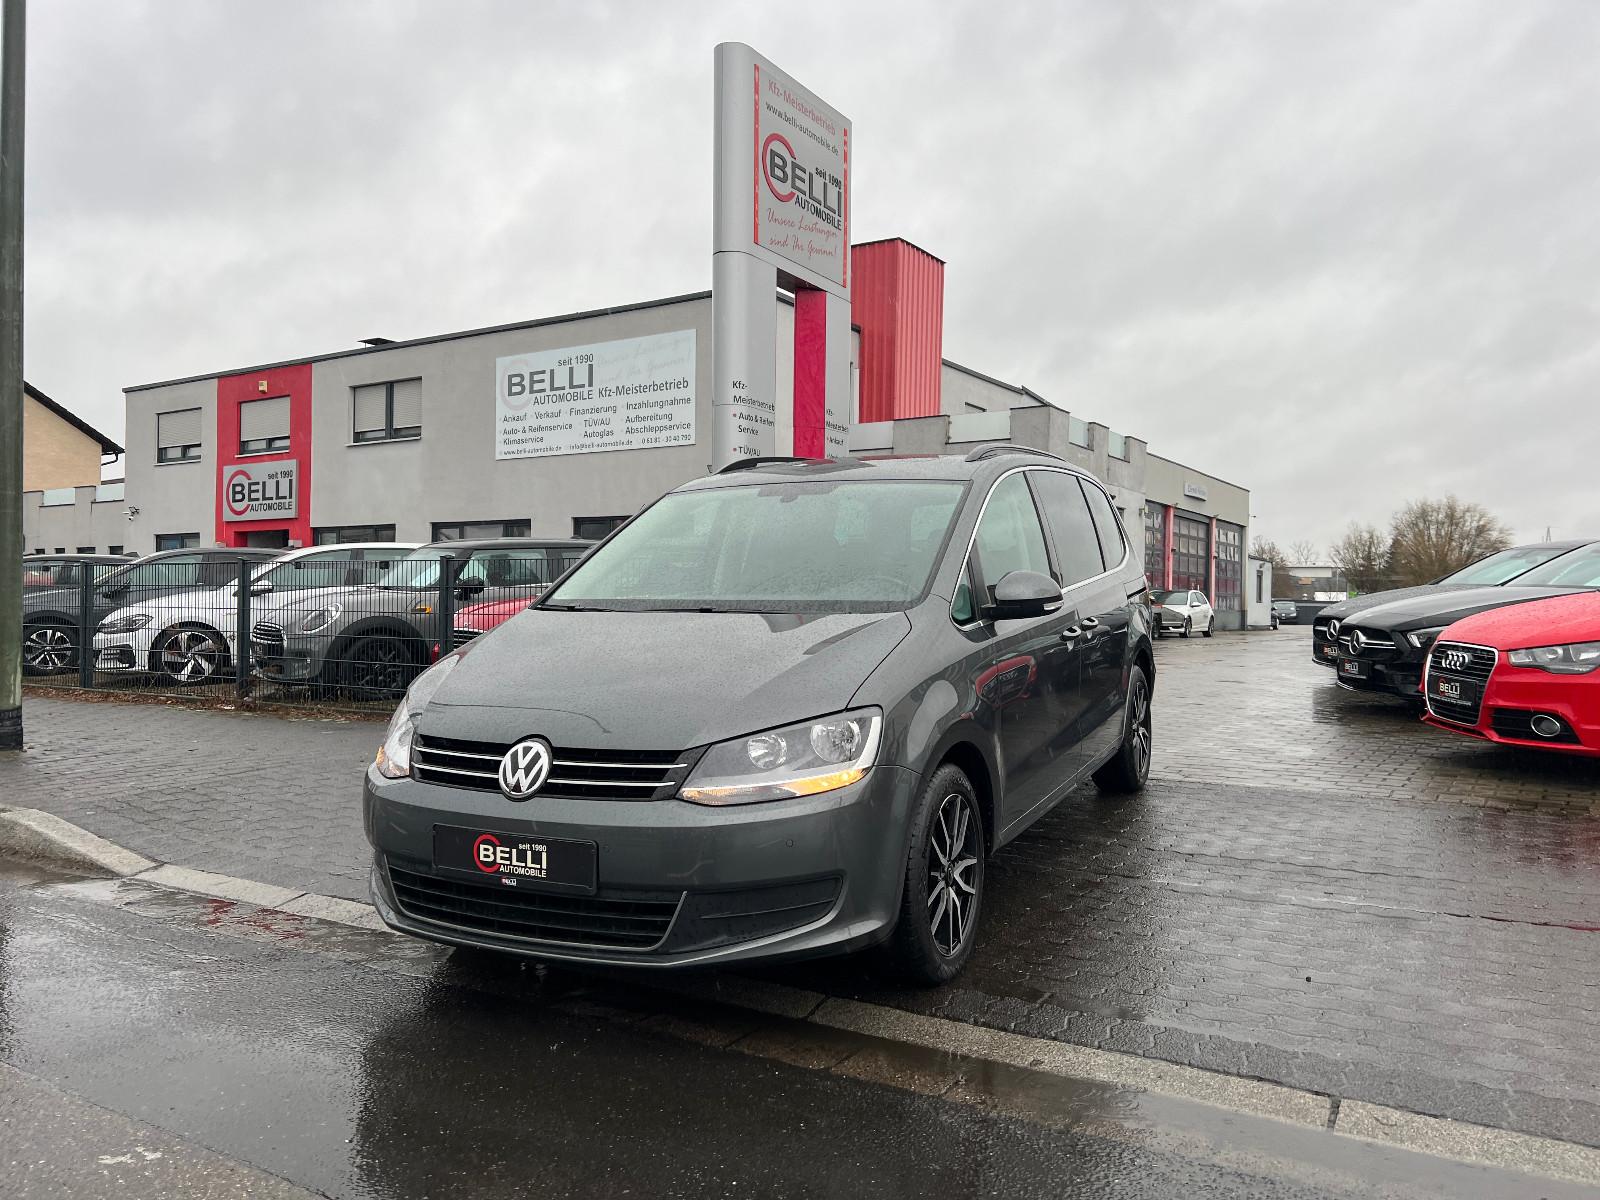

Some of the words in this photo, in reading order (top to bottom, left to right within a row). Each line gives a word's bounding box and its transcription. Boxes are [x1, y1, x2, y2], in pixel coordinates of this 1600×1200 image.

[768, 79, 836, 136] Kfz-Meisterbetrieb
[765, 101, 838, 155] www.belli-automobile.de
[769, 148, 842, 218] BELLI
[815, 167, 827, 181] seit
[828, 171, 842, 191] 1990
[795, 194, 842, 231] AUTOMOBILE
[558, 358, 572, 367] seit
[574, 353, 594, 364] 1990
[507, 363, 594, 397] BELLI
[598, 377, 689, 399] Kfz-Meisterbetrieb
[732, 380, 748, 389] Kfz-
[533, 390, 594, 406] AUTOMOBILE
[733, 395, 775, 412] Meisterbetrieb
[503, 413, 527, 423] Ankauf
[534, 409, 561, 420] Verkauf
[569, 404, 617, 417] Finanzierung
[626, 397, 691, 411] Inzahlungnahme
[738, 412, 753, 422] Auto
[754, 415, 758, 423] &
[503, 427, 520, 435] Auto-
[521, 426, 527, 434] &
[528, 422, 573, 433] Reifenservice
[583, 417, 611, 428] TÜV/AU
[625, 413, 673, 424] Aufbereitung
[503, 436, 544, 446] Klimaservice
[583, 429, 614, 439] Autoglas
[625, 421, 691, 434] Abschleppservice
[738, 424, 759, 435] Service
[280, 470, 293, 478] 1990
[231, 479, 293, 503] BELLI
[250, 501, 292, 512] AUTOMOBILE
[1440, 682, 1460, 694] BELLI
[479, 844, 547, 869] BELLI
[532, 843, 547, 851] 1990
[499, 864, 547, 878] AUTOMOBILE
